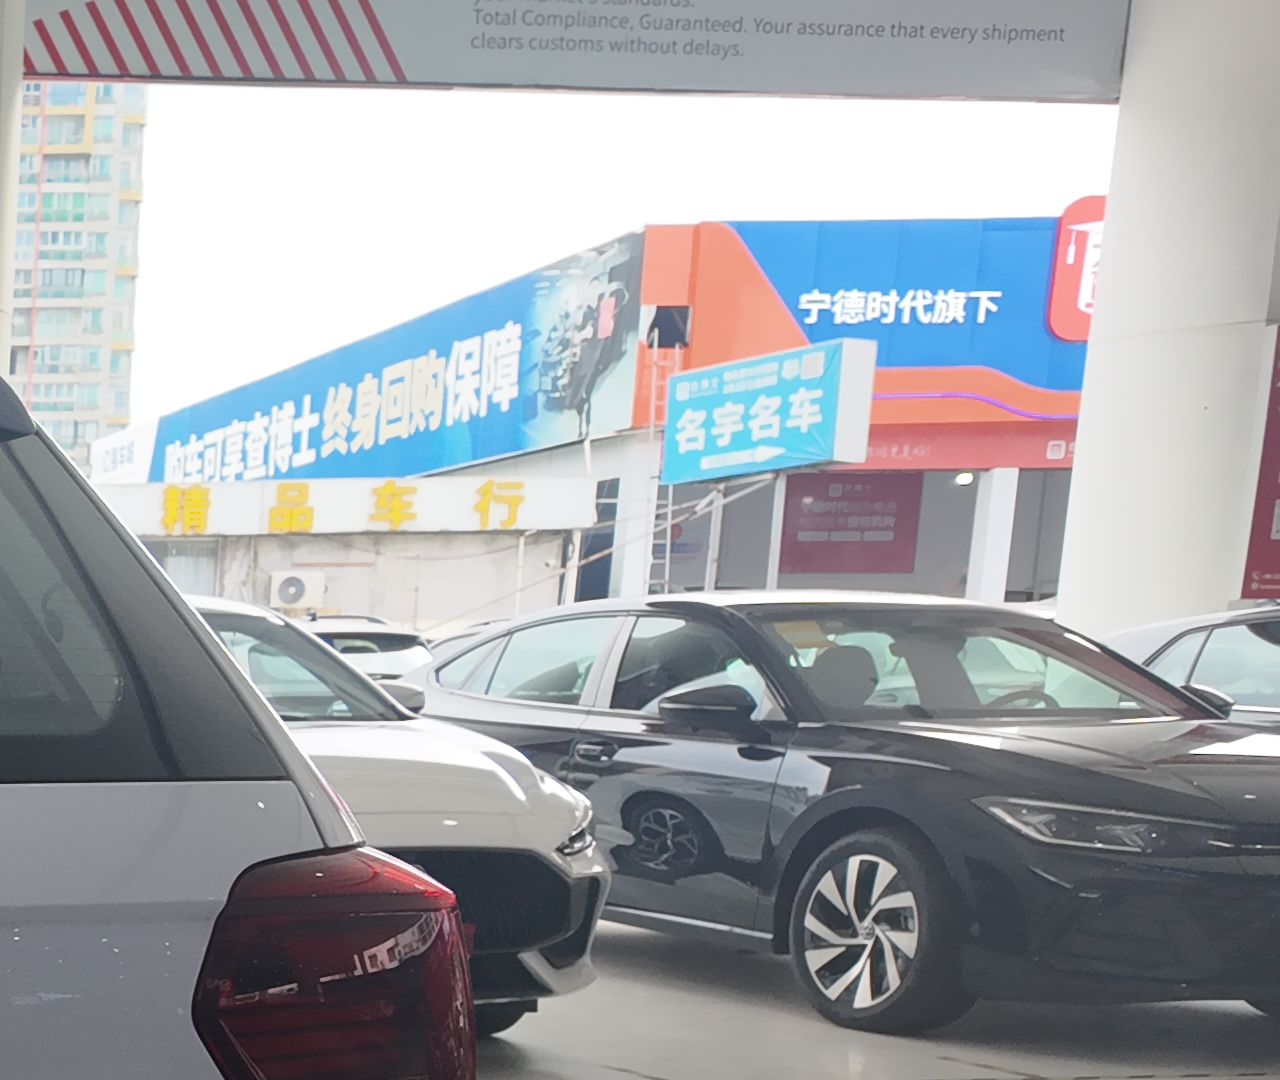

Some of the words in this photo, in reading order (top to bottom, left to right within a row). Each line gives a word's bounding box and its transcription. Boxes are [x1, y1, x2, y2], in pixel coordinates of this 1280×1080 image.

[473, 9, 516, 26] Total
[521, 9, 634, 31] Compliance,
[639, 14, 748, 33] Guaranteed.
[753, 18, 793, 35] Your
[797, 21, 885, 37] assurance
[890, 22, 925, 39] that
[930, 26, 978, 44] every
[982, 24, 1066, 45] shipment
[470, 33, 524, 50] clears
[528, 35, 604, 52] customs
[608, 37, 677, 55] without
[682, 39, 745, 60] delays.
[798, 288, 1003, 324] 宁德时代旗下
[674, 386, 825, 455] 名宇名车
[161, 478, 526, 536] 精品车行
